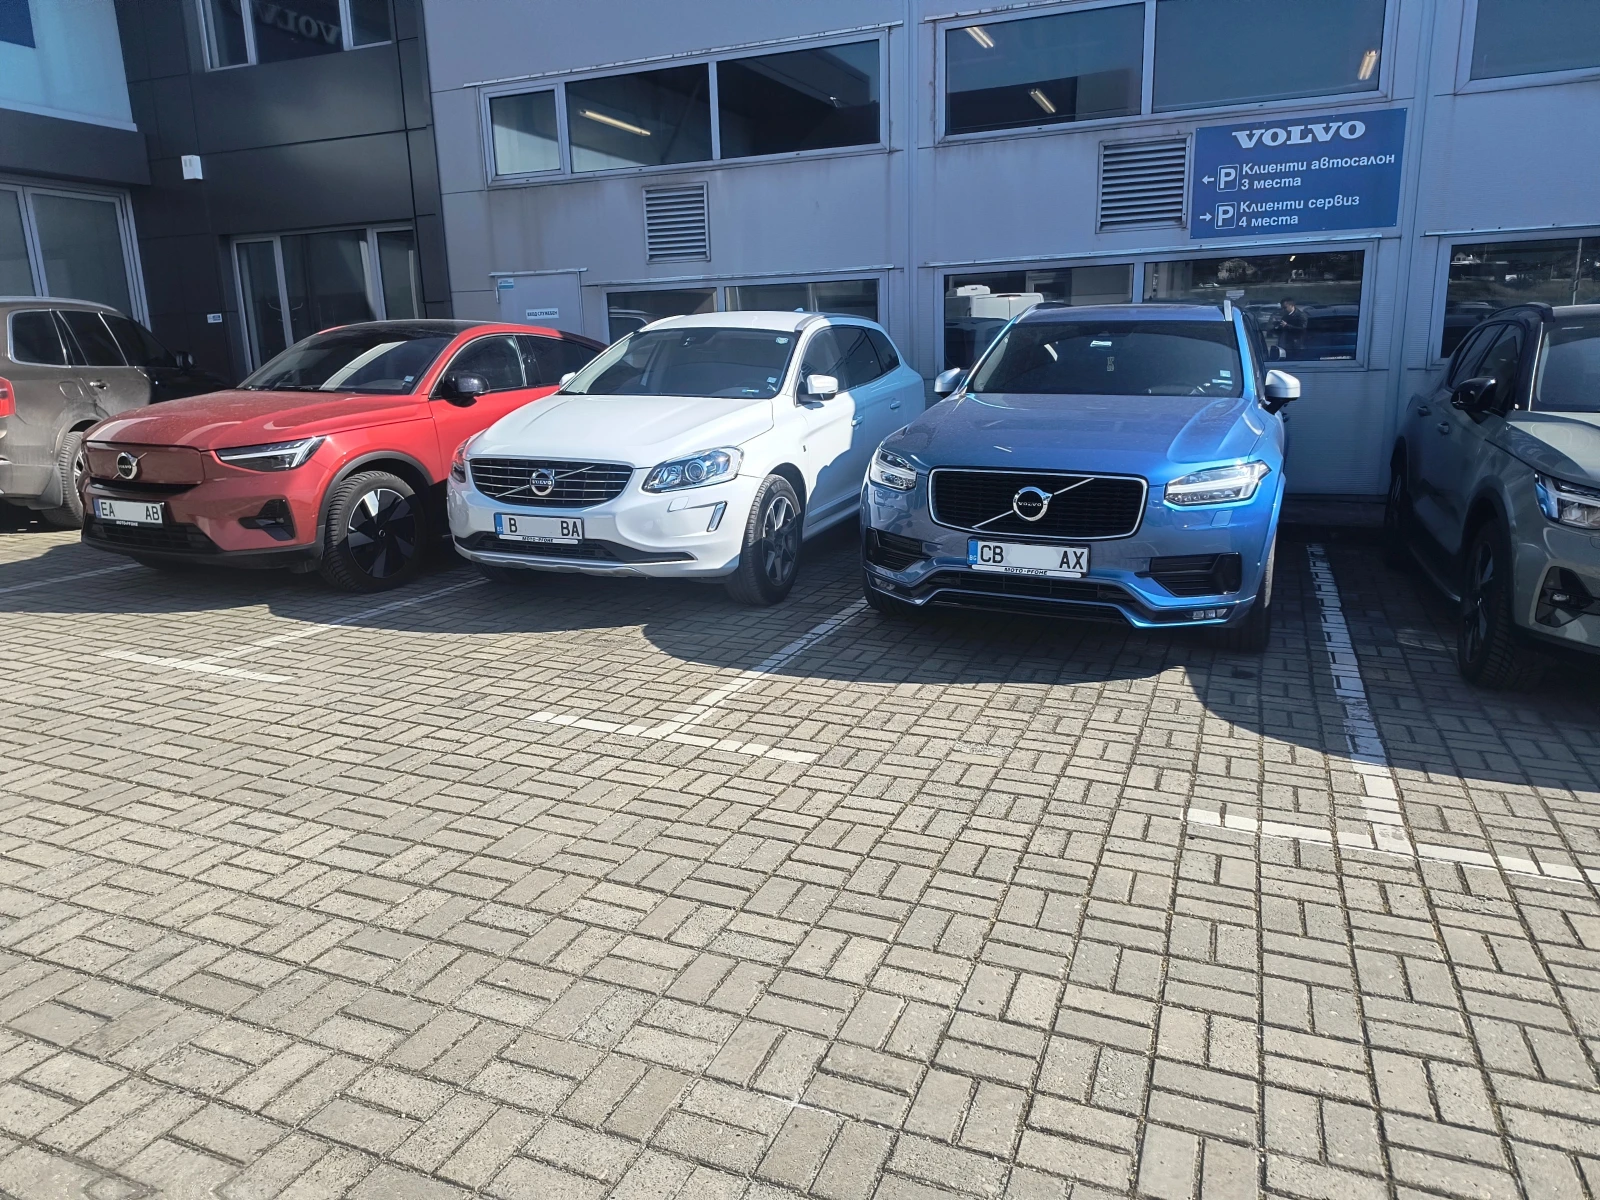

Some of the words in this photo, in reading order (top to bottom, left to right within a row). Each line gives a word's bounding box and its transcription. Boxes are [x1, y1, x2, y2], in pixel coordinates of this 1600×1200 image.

[1231, 120, 1366, 149] VOLVO
[1242, 161, 1307, 175] Клиенти
[1311, 154, 1395, 170] автосалон
[1219, 168, 1236, 189] P
[1241, 179, 1249, 190] 3
[1253, 177, 1302, 189] места
[1240, 200, 1304, 213] Клиенти
[1308, 195, 1360, 211] сервиз
[1217, 206, 1234, 226] P
[1239, 217, 1247, 227] 4
[1251, 214, 1299, 227] места
[100, 501, 116, 518] EA
[145, 505, 160, 521] AB
[508, 517, 518, 533] B
[560, 520, 580, 537] BA
[980, 544, 1004, 564] CB
[1059, 550, 1085, 570] AX
